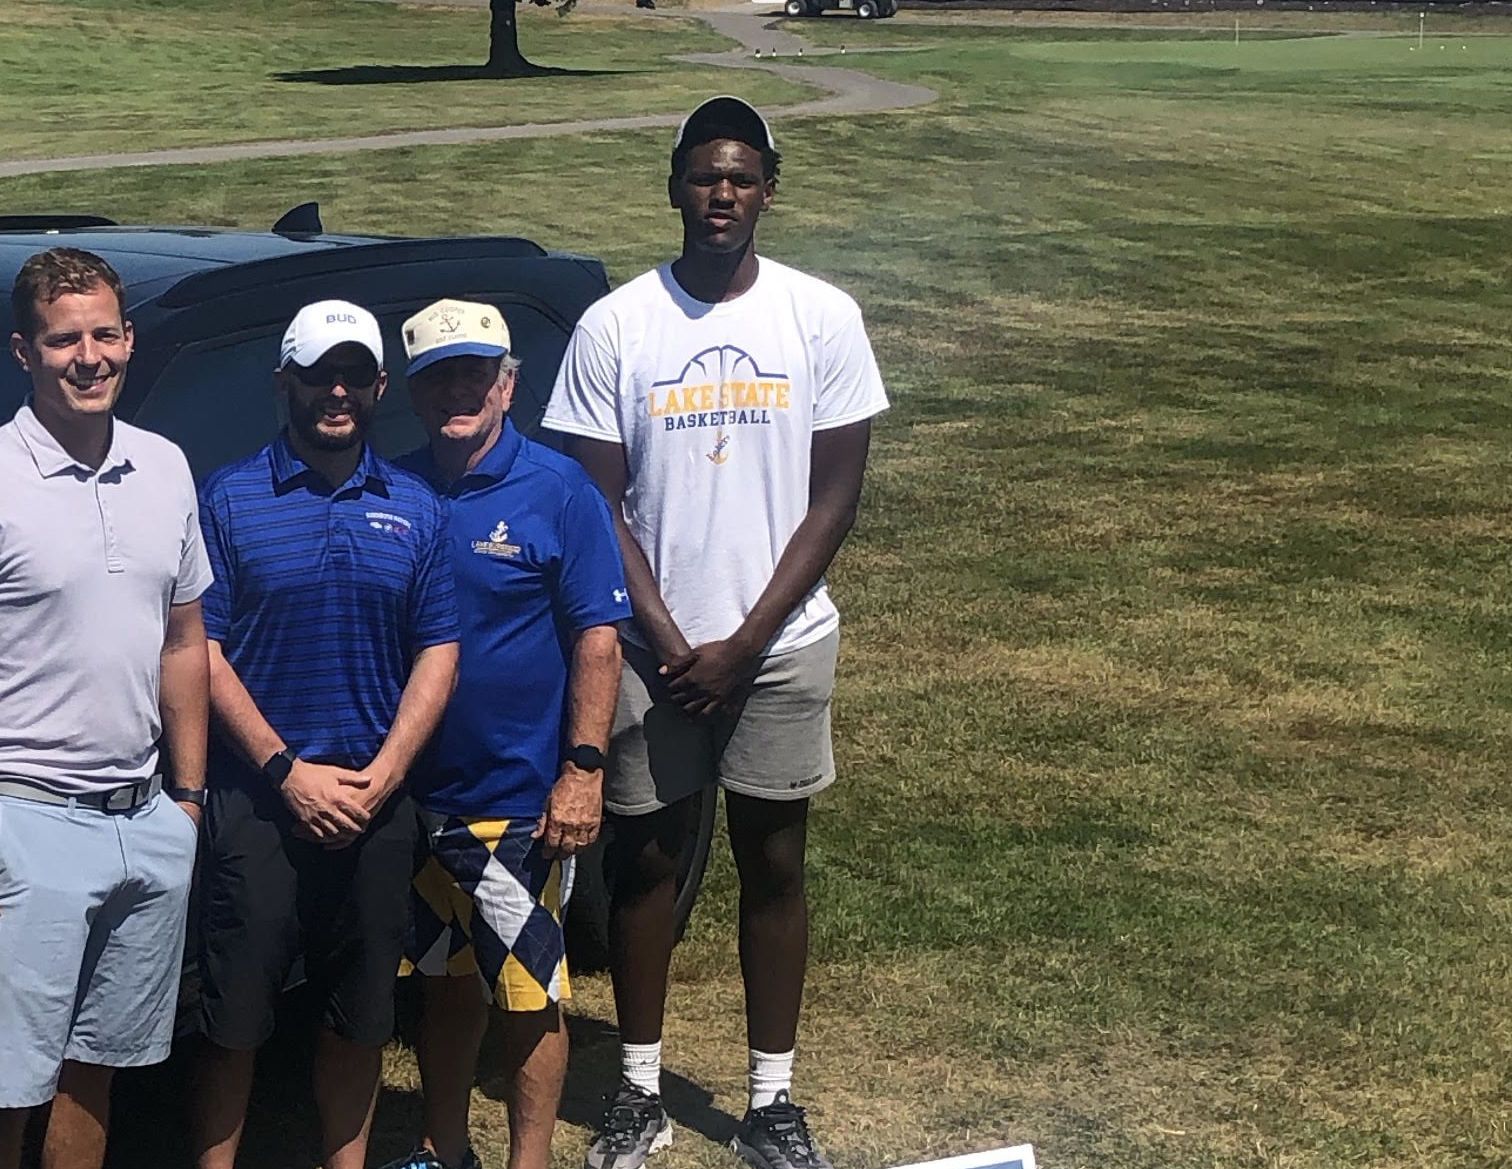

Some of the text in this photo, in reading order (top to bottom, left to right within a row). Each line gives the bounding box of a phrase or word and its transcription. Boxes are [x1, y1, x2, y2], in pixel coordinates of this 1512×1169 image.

[326, 313, 357, 325] BUD
[648, 382, 790, 417] LAKE STATE
[664, 409, 771, 431] BASKETBALL
